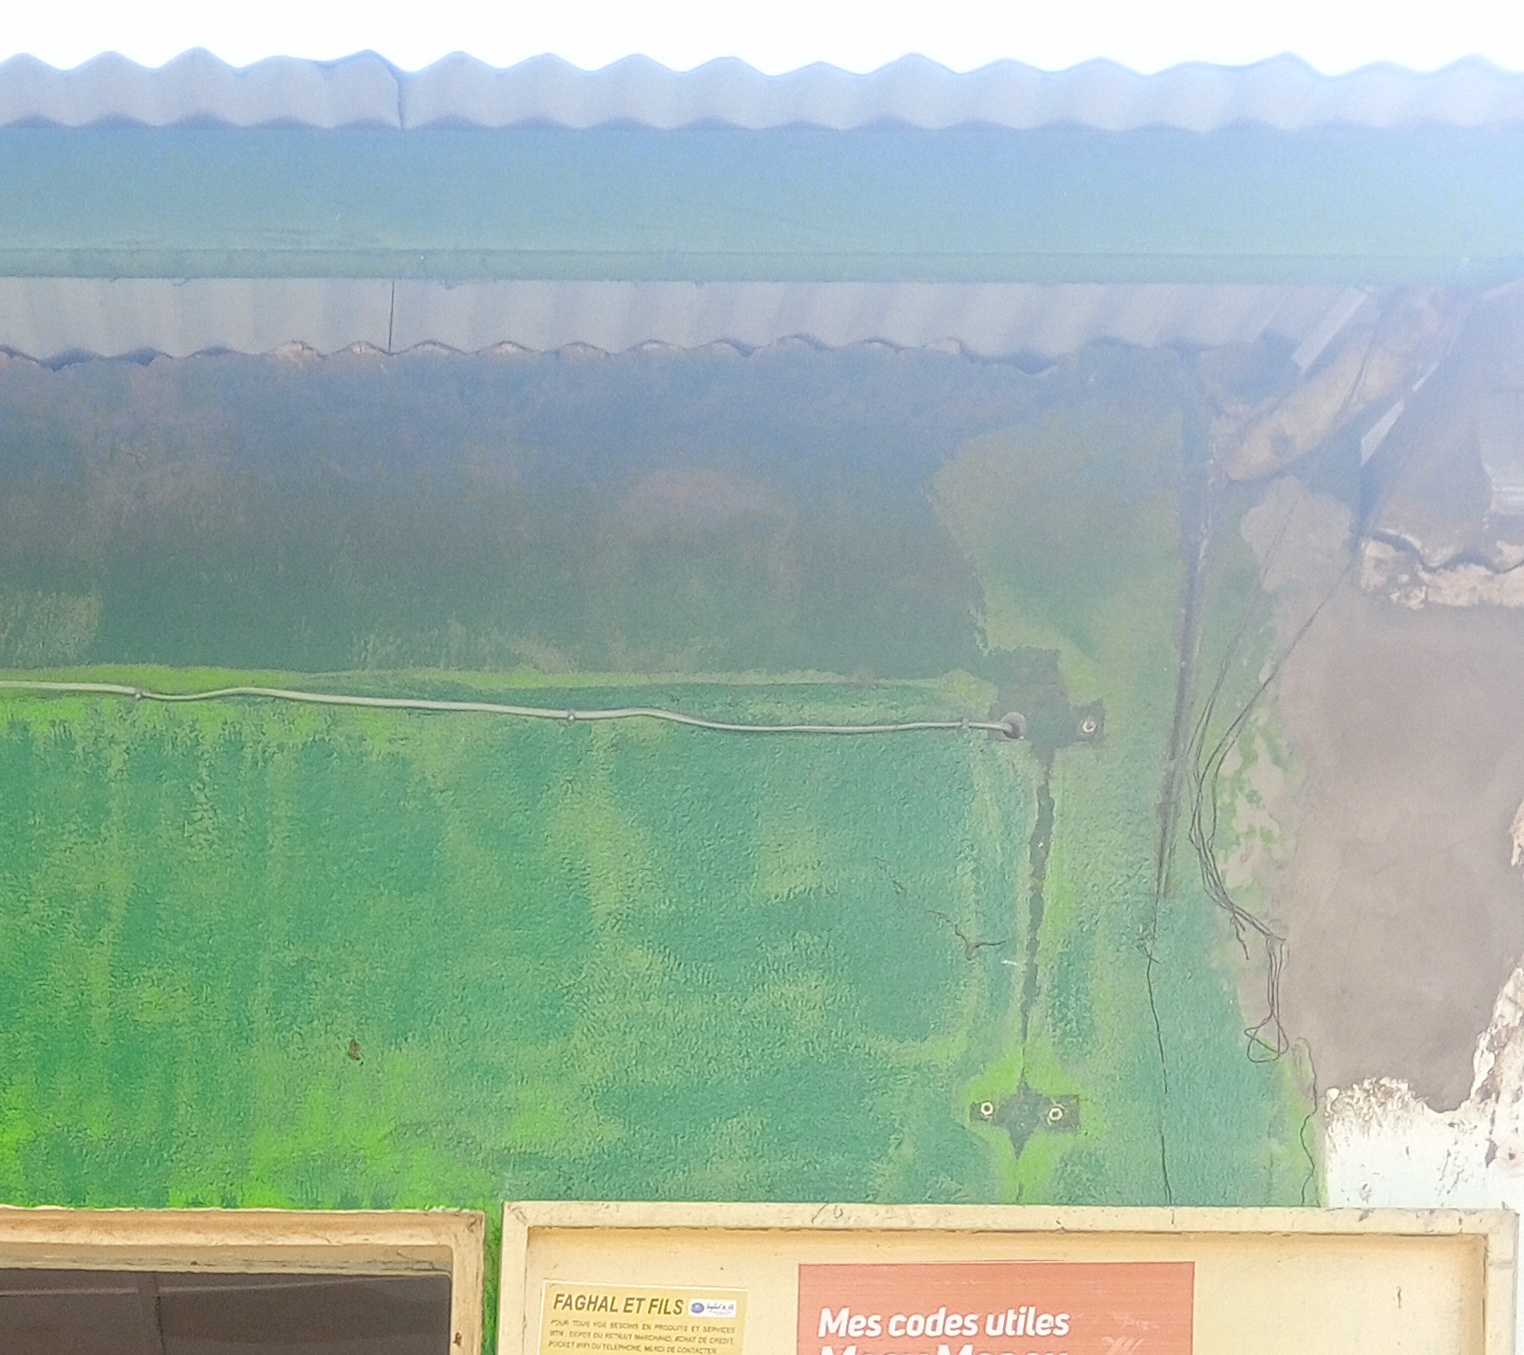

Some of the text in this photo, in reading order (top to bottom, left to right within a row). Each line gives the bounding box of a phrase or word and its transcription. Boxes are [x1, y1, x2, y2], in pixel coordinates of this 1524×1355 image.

[553, 1293, 618, 1312] FAGHAL
[623, 1297, 646, 1314] ET
[648, 1297, 684, 1315] FILS
[817, 1306, 1070, 1338] Mes codes utiles
